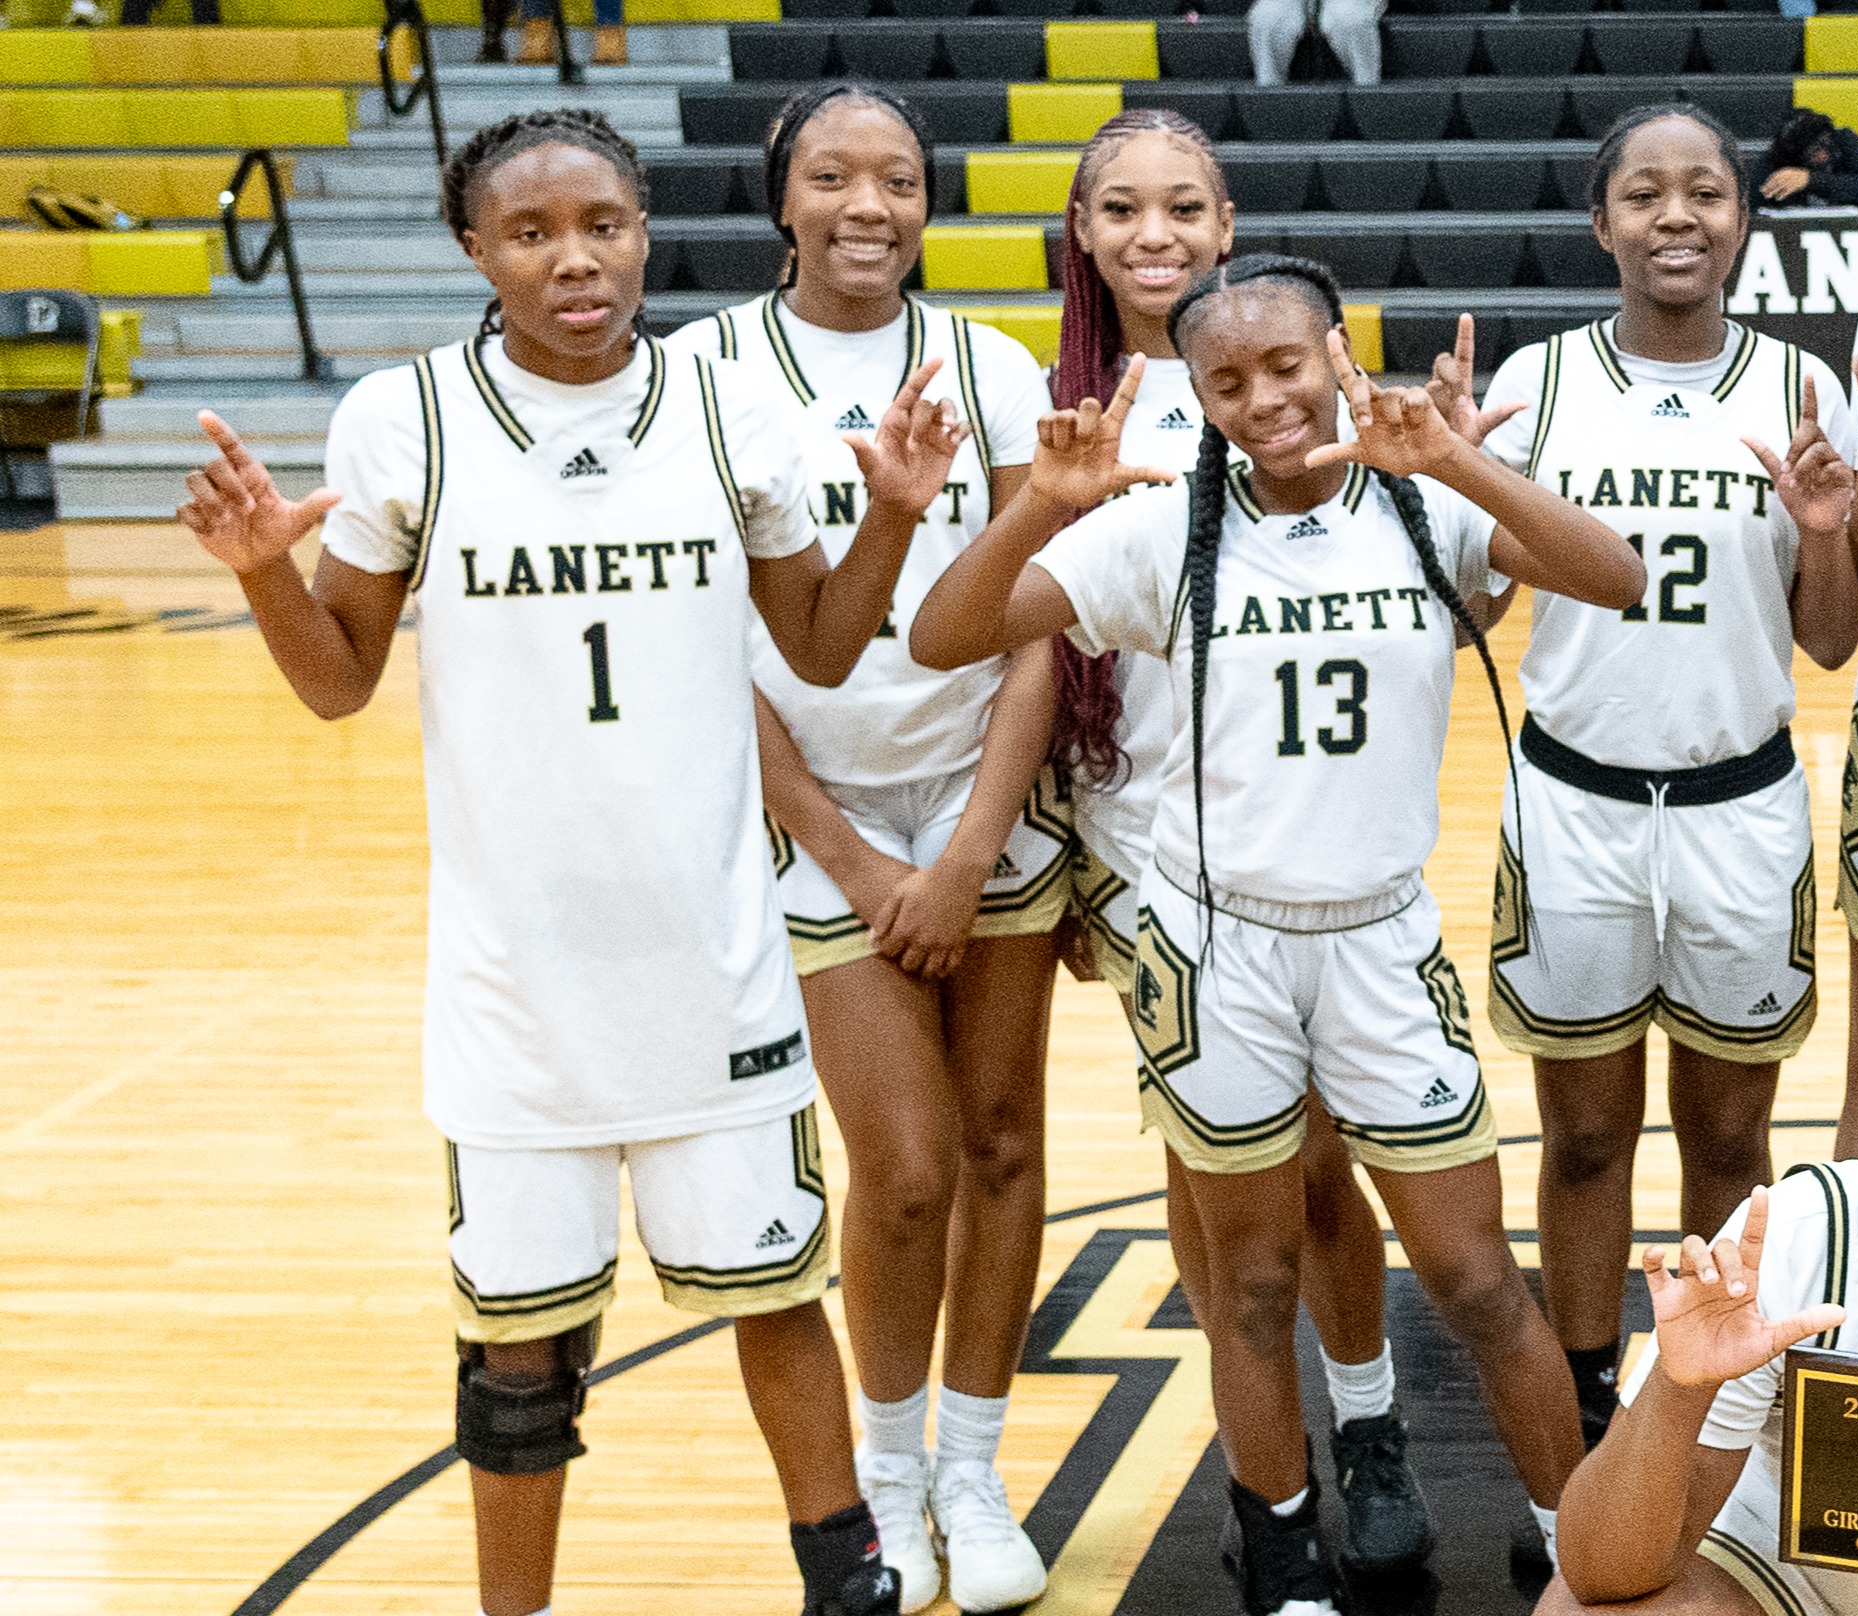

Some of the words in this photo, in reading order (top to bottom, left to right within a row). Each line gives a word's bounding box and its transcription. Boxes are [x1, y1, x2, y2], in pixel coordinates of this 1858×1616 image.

[1650, 408, 1691, 419] adidas
[1559, 469, 1776, 518] LANETT
[1286, 527, 1329, 541] adidas
[460, 539, 717, 598] LANETT
[583, 622, 620, 724] 1
[1275, 659, 1370, 757] 13
[1419, 1093, 1459, 1108] adidas
